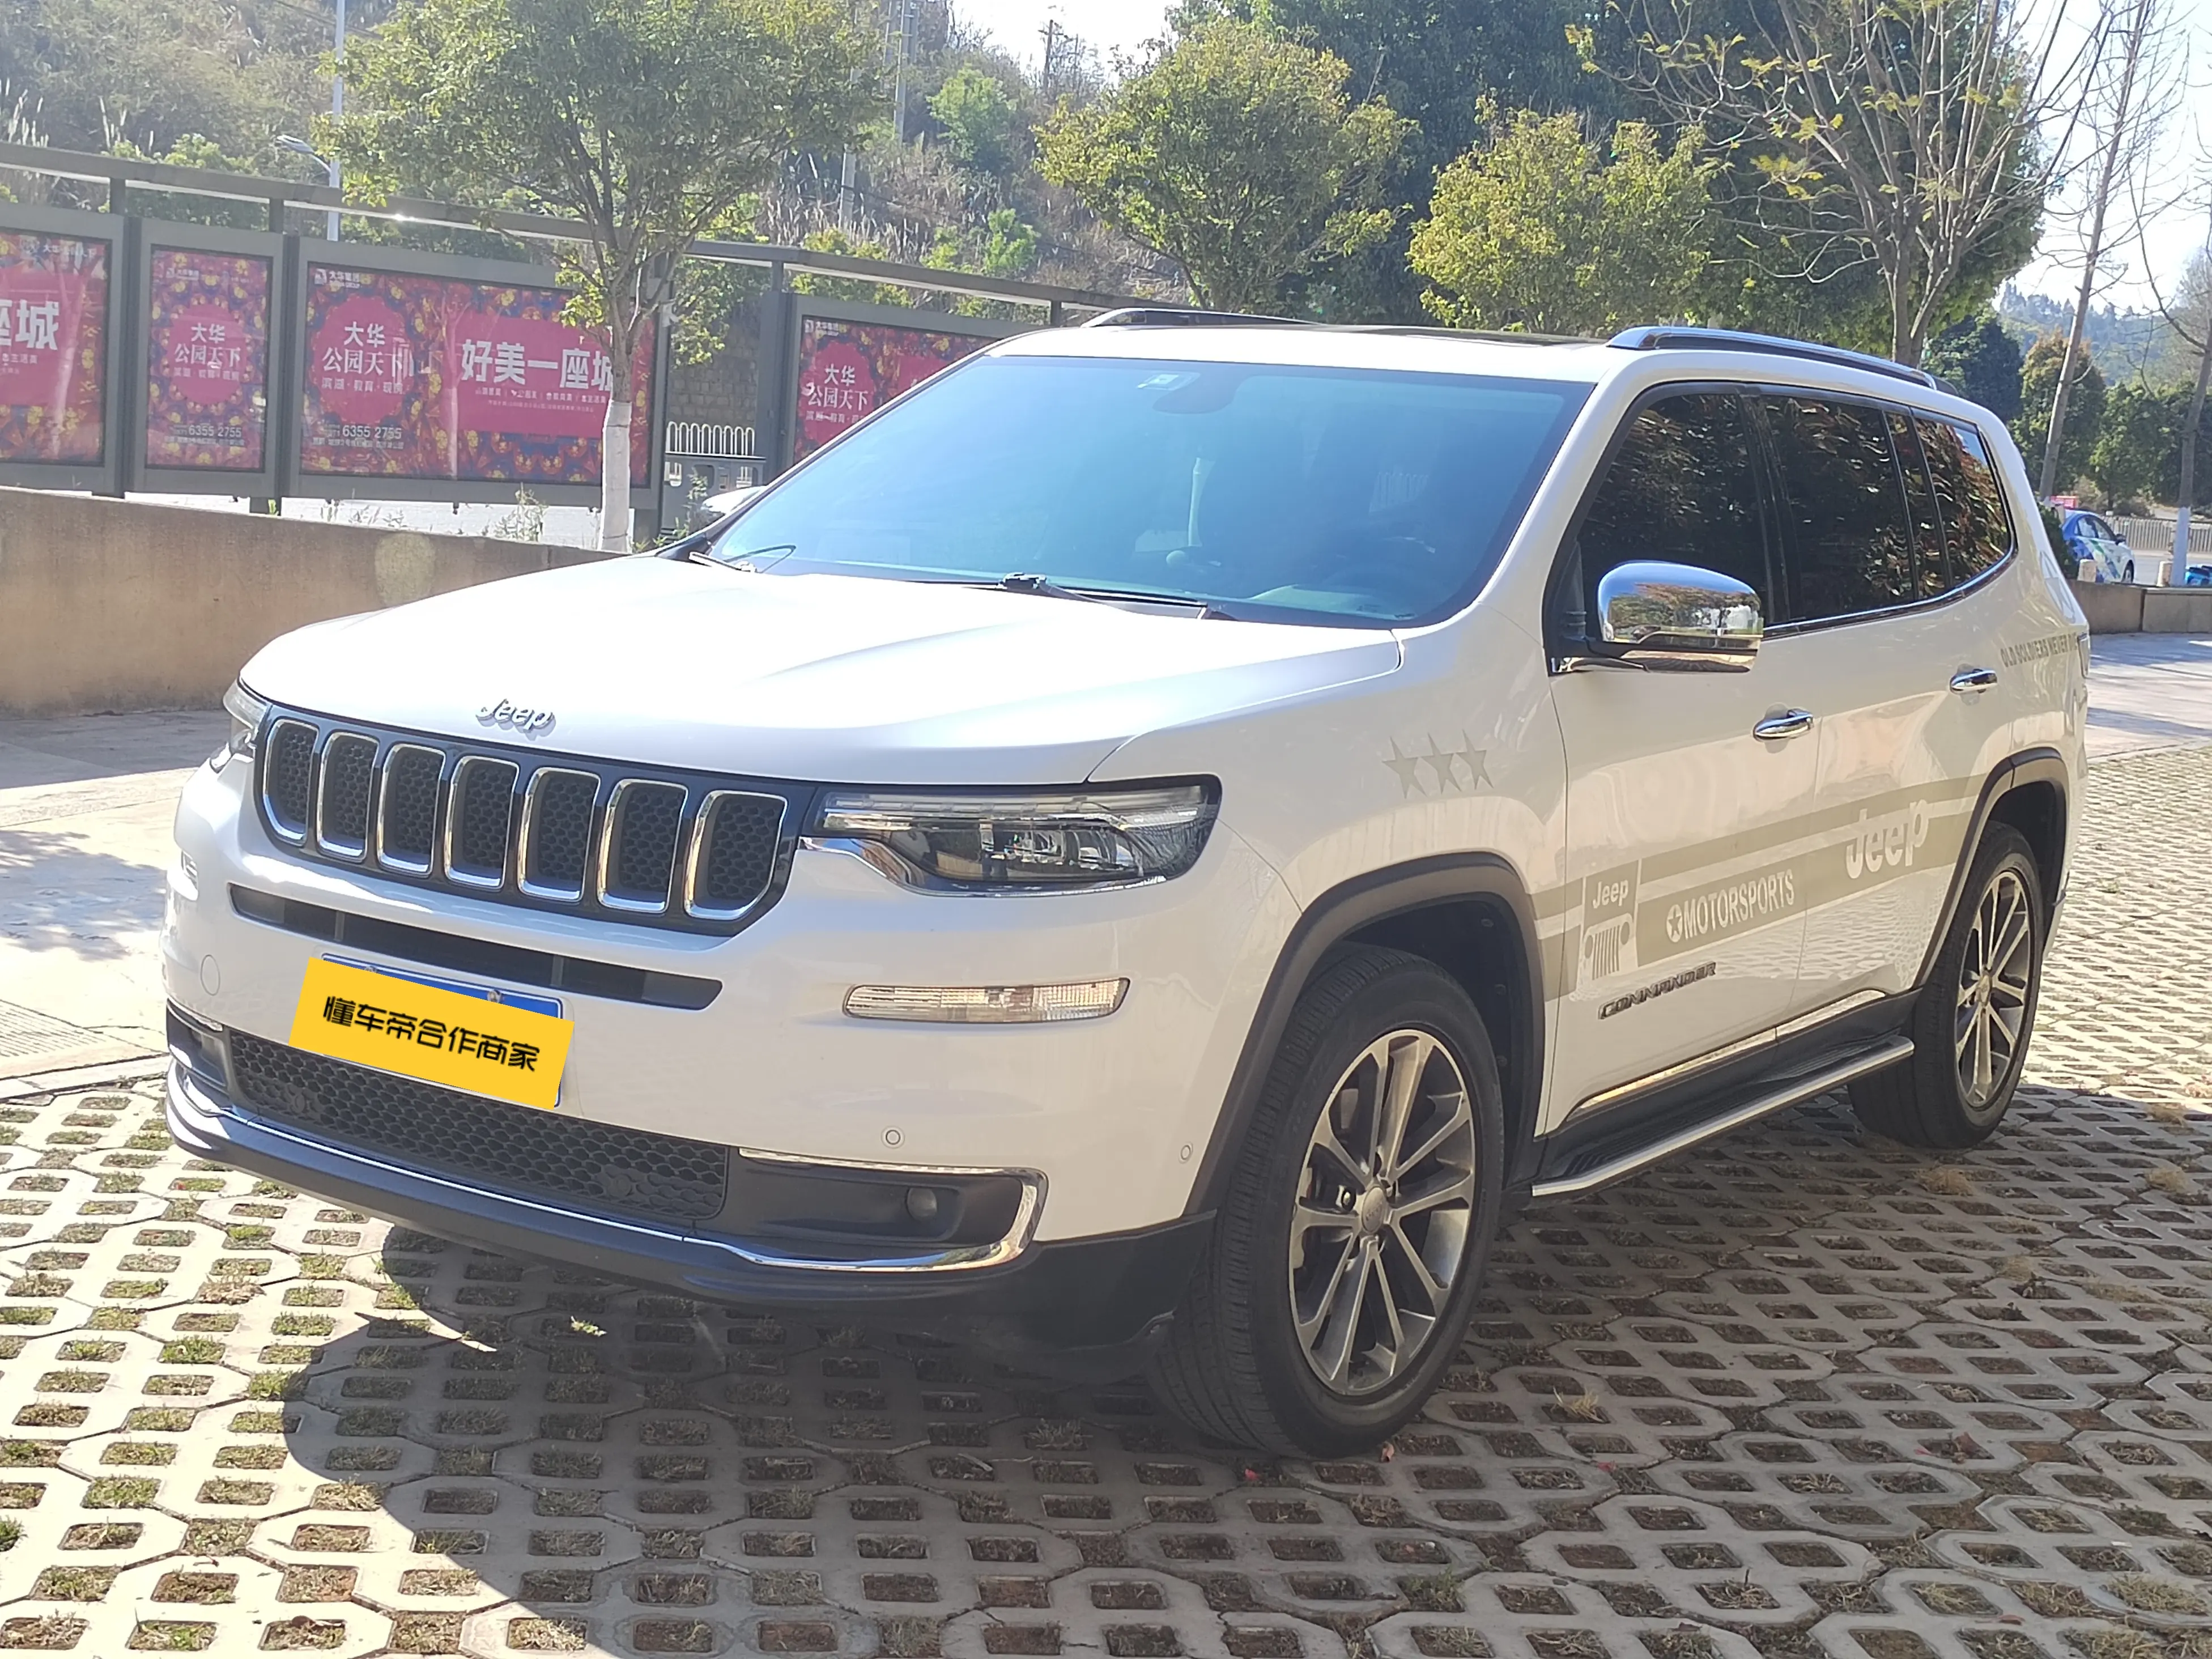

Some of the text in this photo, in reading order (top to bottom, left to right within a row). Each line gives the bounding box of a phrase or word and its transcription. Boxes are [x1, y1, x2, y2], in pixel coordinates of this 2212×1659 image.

[190, 322, 226, 343] 大华
[344, 321, 385, 348] 大华
[174, 343, 241, 367] 公园天下
[322, 347, 403, 378] 公园天下
[461, 339, 612, 391] 好美一座城
[824, 363, 856, 386] 大华
[807, 386, 869, 411] 公园天下
[189, 425, 214, 436] 6355
[218, 427, 242, 437] 2755
[342, 425, 371, 437] 6355
[375, 427, 402, 439] 2755
[475, 699, 554, 733] Jeep
[1846, 799, 1929, 878] Jeep
[1593, 879, 1629, 909] Jeep
[1683, 869, 1795, 940] MOTORSPORTS
